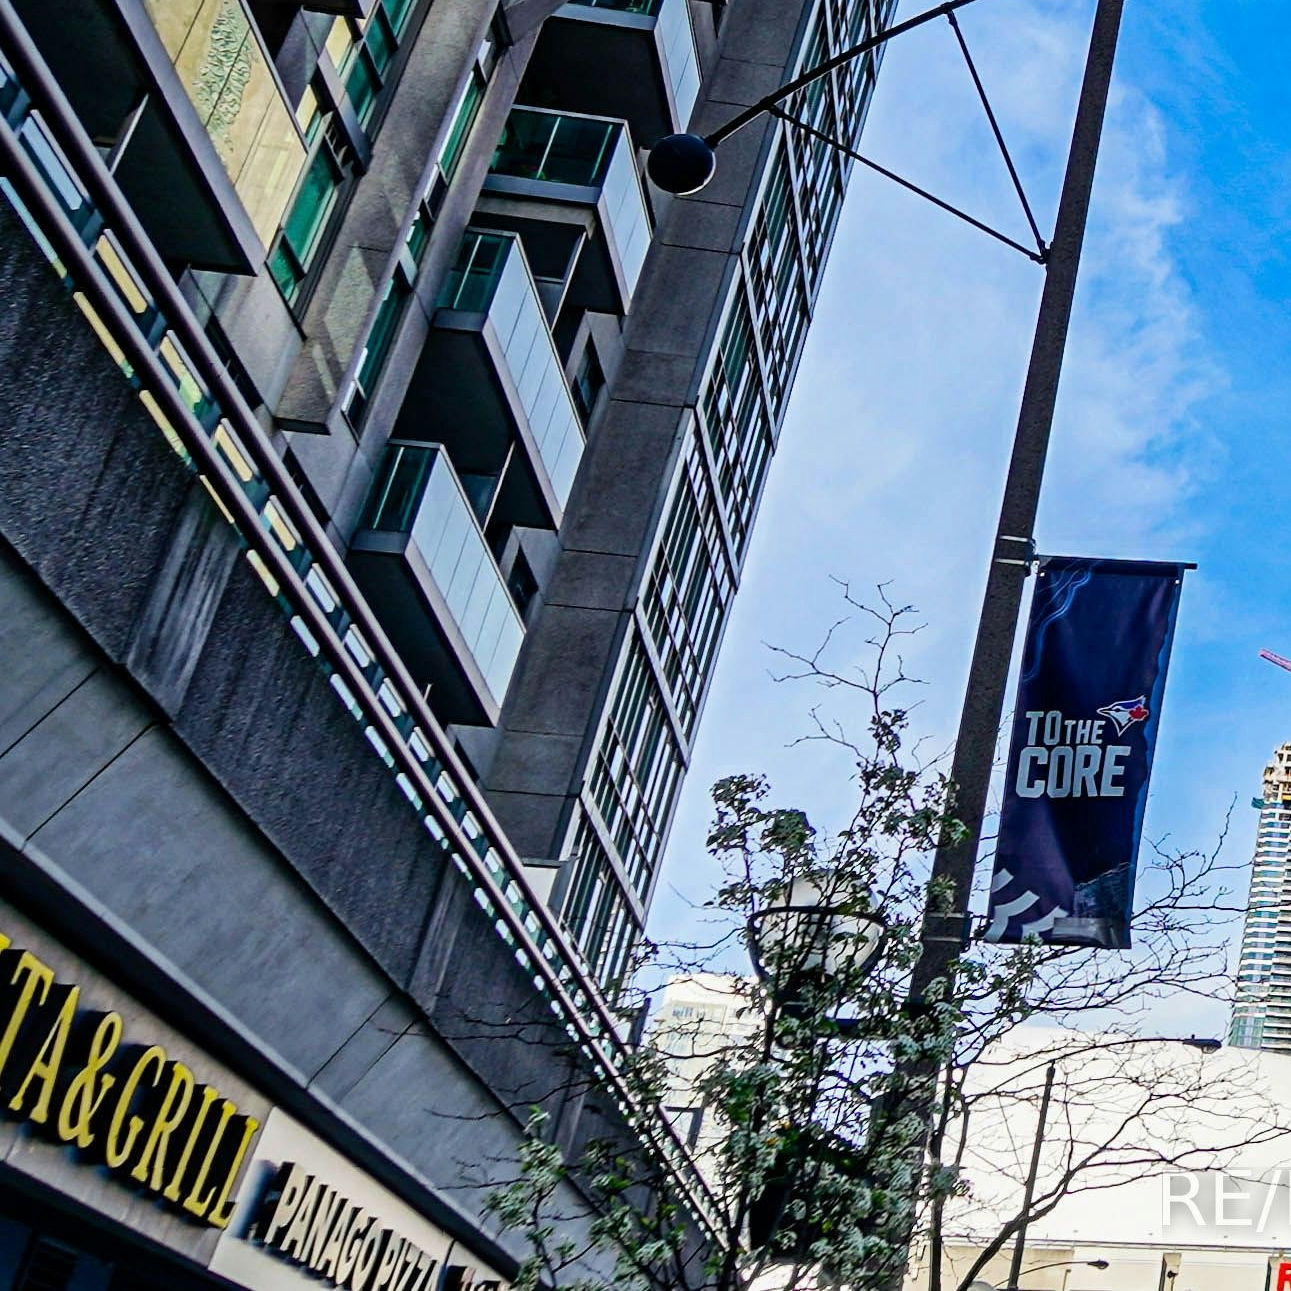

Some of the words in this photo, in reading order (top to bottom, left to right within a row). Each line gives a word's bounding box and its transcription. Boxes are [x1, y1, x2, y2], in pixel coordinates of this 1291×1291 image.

[1026, 710, 1062, 745] TO
[1064, 719, 1106, 744] THE
[1016, 745, 1132, 799] CORE
[264, 1164, 382, 1291] PANAGO
